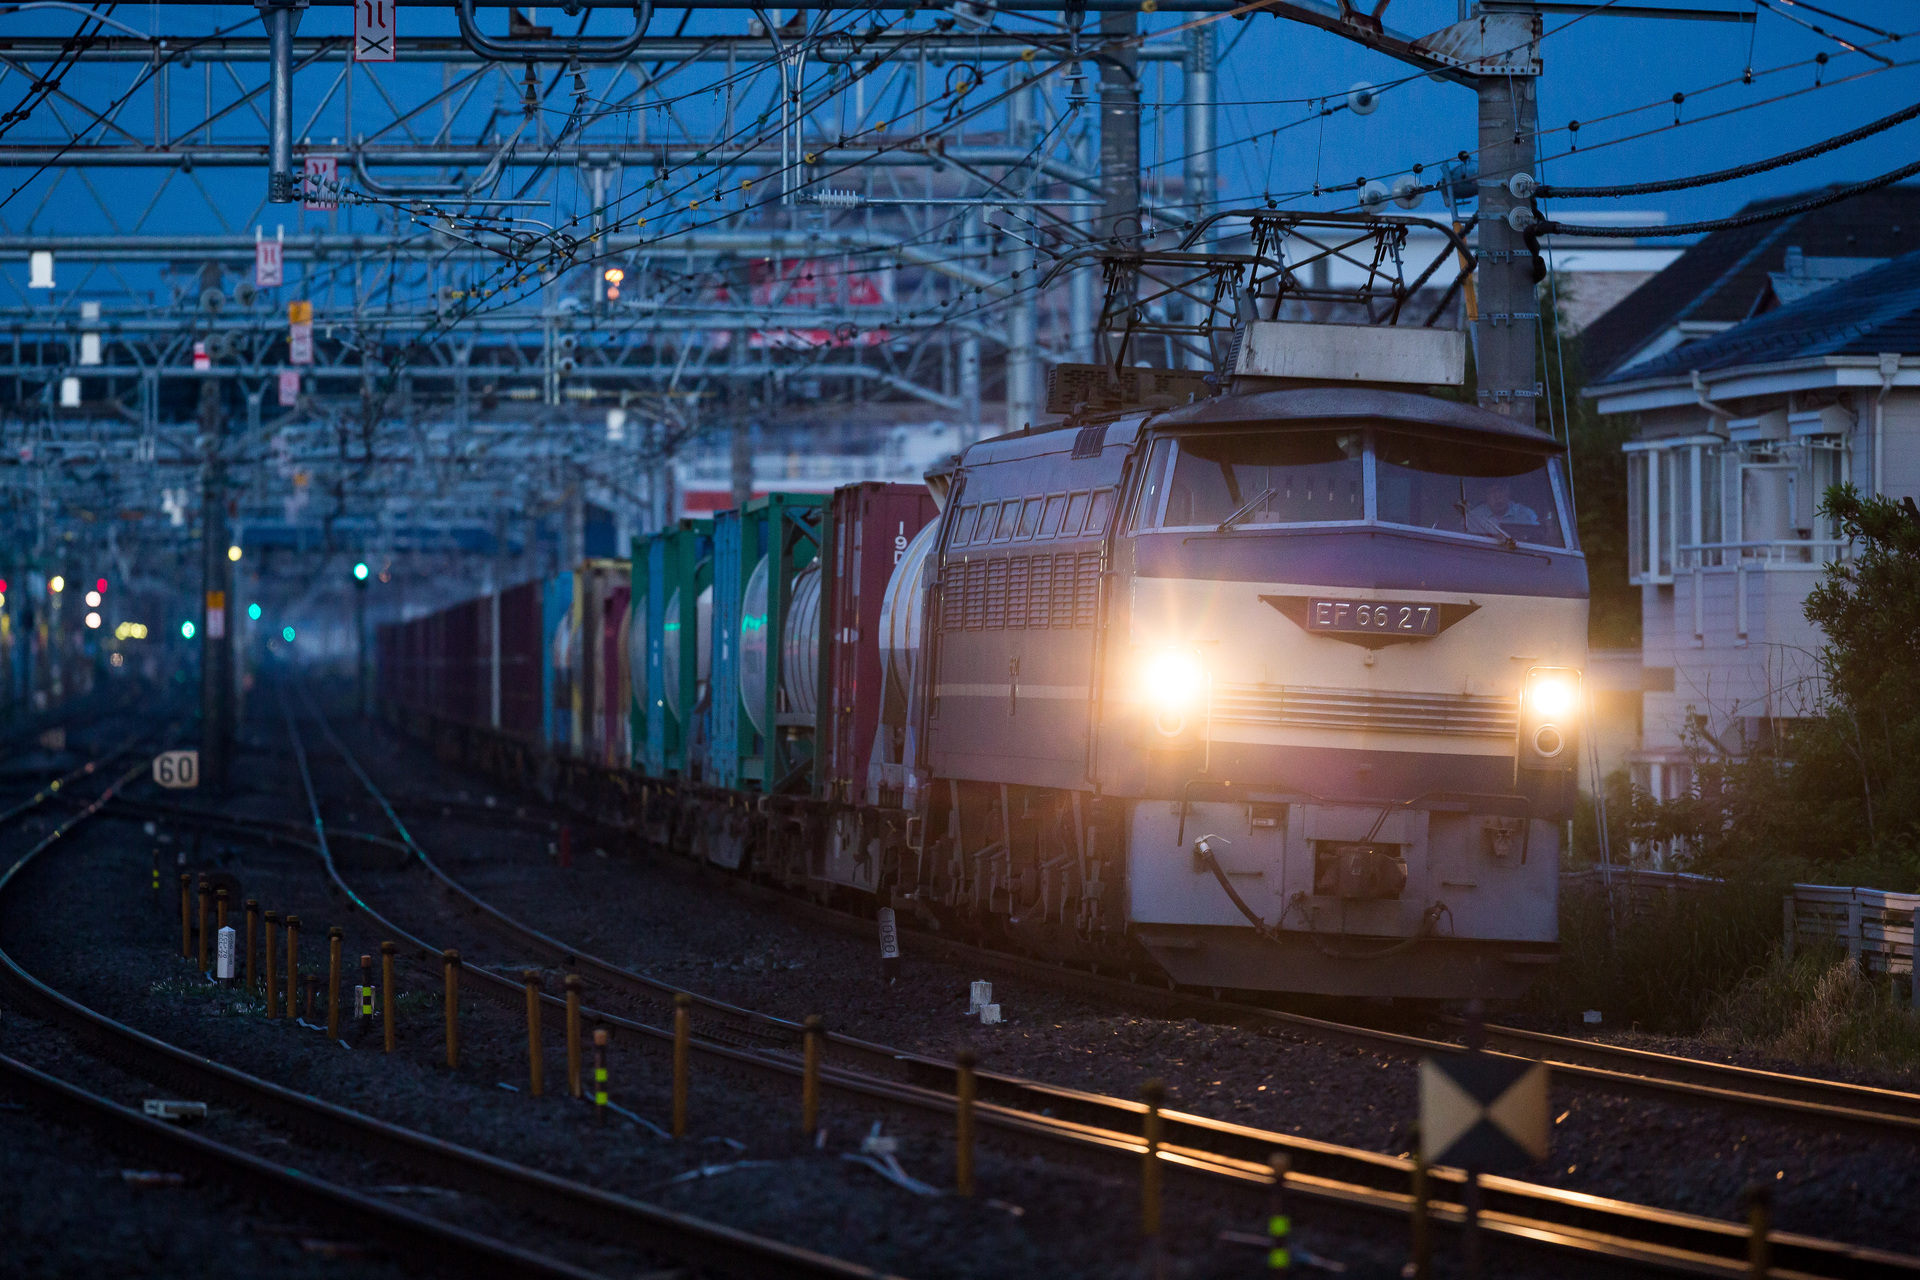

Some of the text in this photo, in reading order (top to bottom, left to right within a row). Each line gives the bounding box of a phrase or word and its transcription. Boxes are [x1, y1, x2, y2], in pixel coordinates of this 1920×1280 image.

[1316, 602, 1431, 631] EF 66 27
[160, 756, 192, 783] 60
